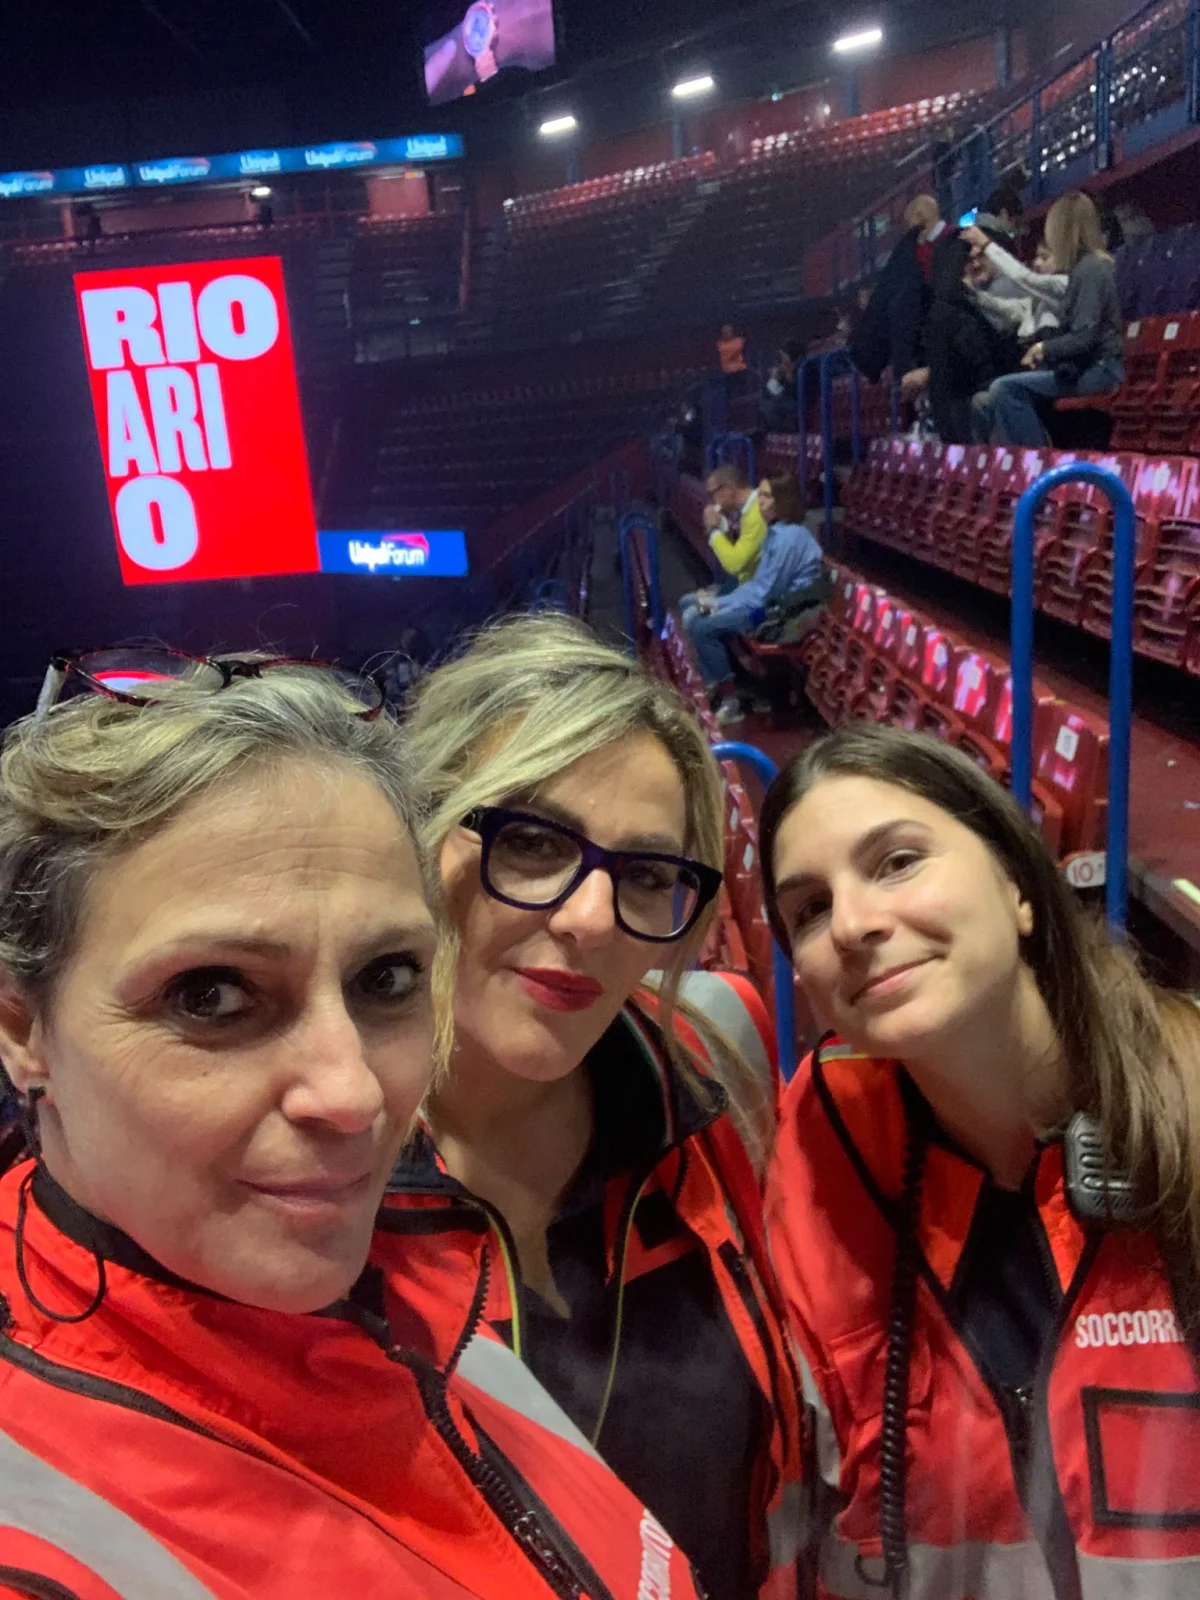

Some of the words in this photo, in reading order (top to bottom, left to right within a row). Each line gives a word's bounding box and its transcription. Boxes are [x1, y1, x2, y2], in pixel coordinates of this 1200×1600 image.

[81, 274, 279, 370] RIO
[106, 362, 232, 478] ARI
[115, 474, 199, 571] O
[1075, 1308, 1185, 1349] SOCCORR
